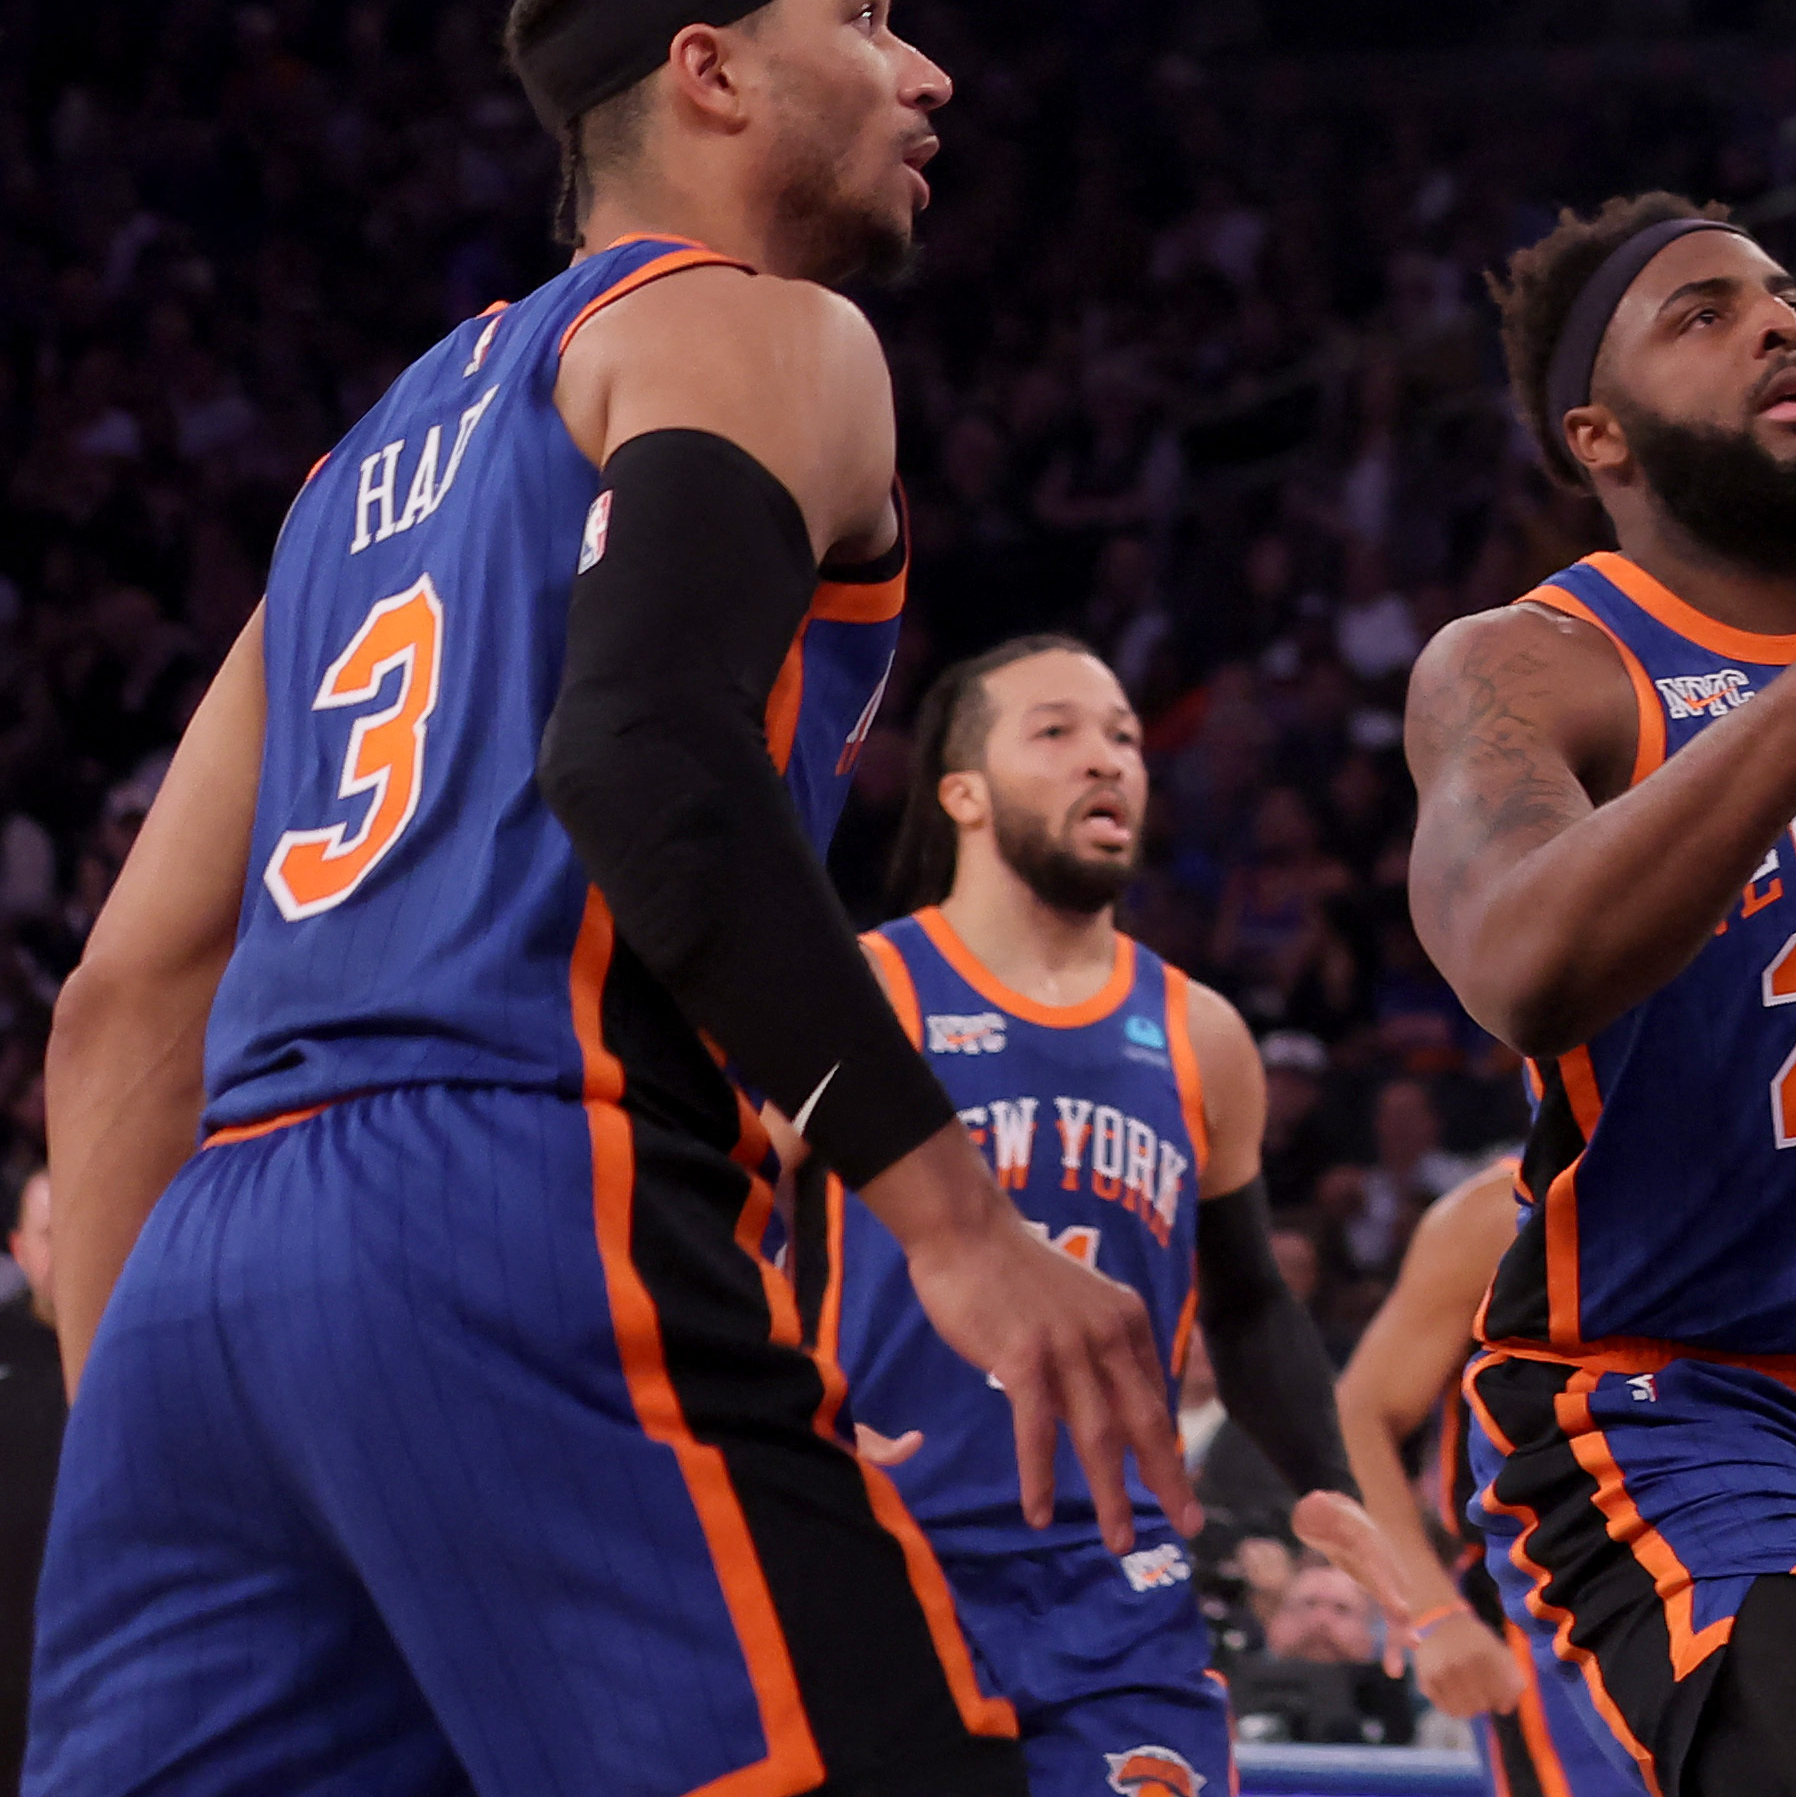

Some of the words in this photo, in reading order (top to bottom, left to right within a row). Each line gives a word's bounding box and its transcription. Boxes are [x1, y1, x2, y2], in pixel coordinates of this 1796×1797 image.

[263, 571, 444, 922] 3
[1654, 668, 1757, 719] NYC
[1052, 1095, 1189, 1249] YORK
